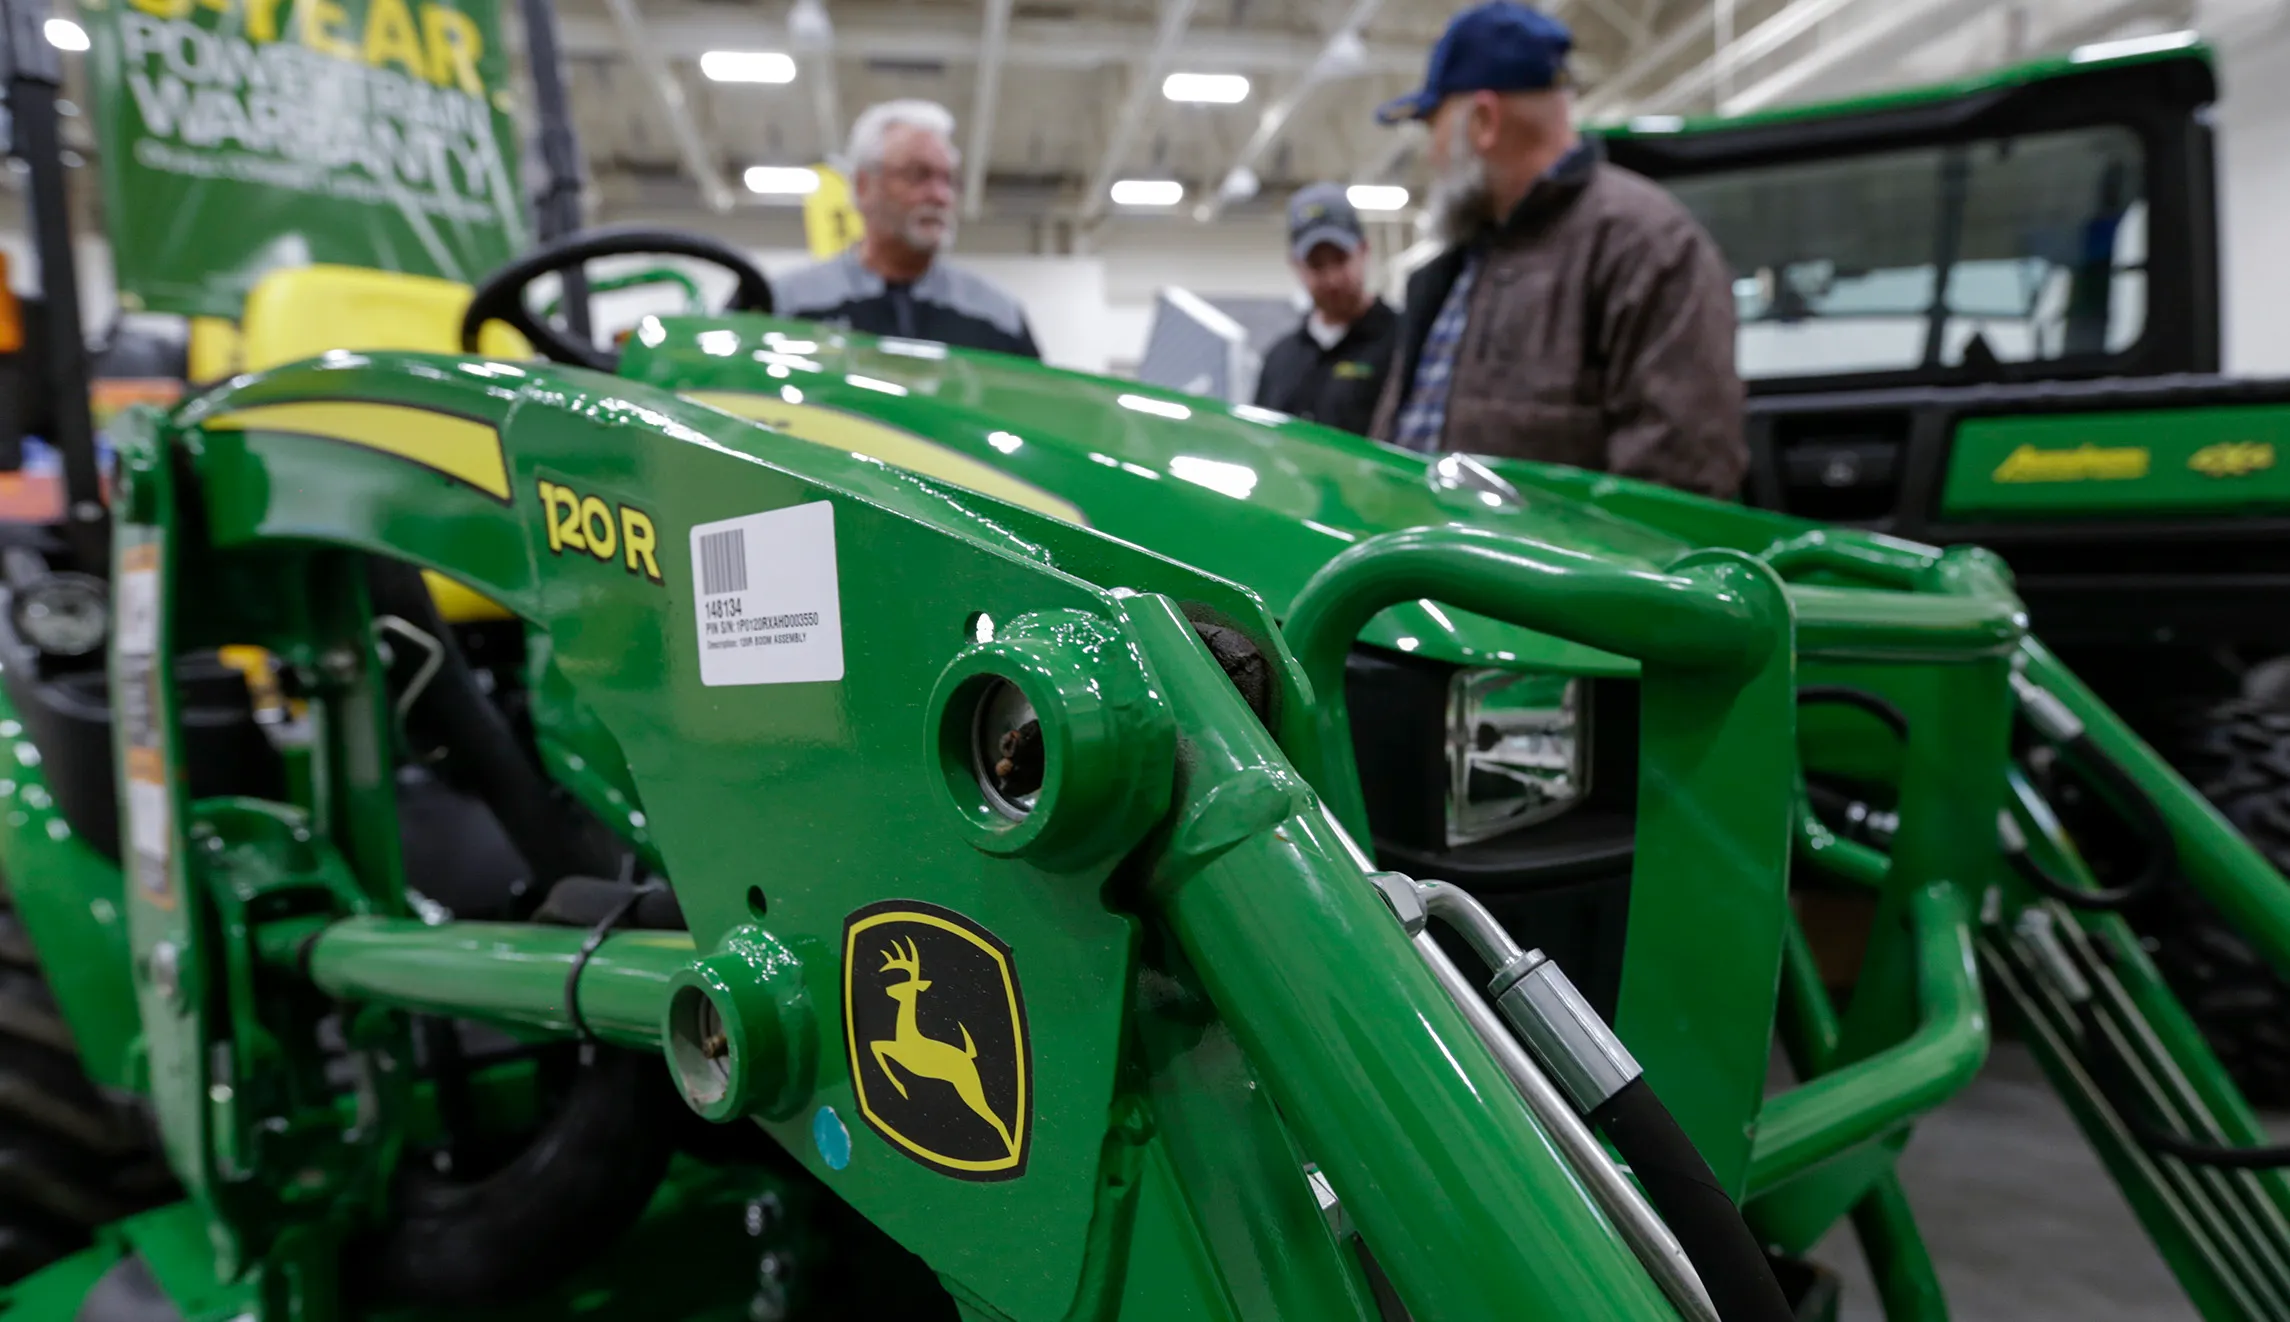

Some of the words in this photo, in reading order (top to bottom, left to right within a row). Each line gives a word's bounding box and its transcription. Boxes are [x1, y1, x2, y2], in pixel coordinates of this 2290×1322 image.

[126, 0, 486, 95] -YEAR
[128, 70, 488, 194] WARRANTY
[538, 479, 617, 561] 120
[619, 504, 662, 582] R
[705, 598, 742, 619] 148134
[705, 622, 719, 636] PIN
[755, 636, 772, 646] BOOM
[774, 632, 806, 644] ASSEMBLY
